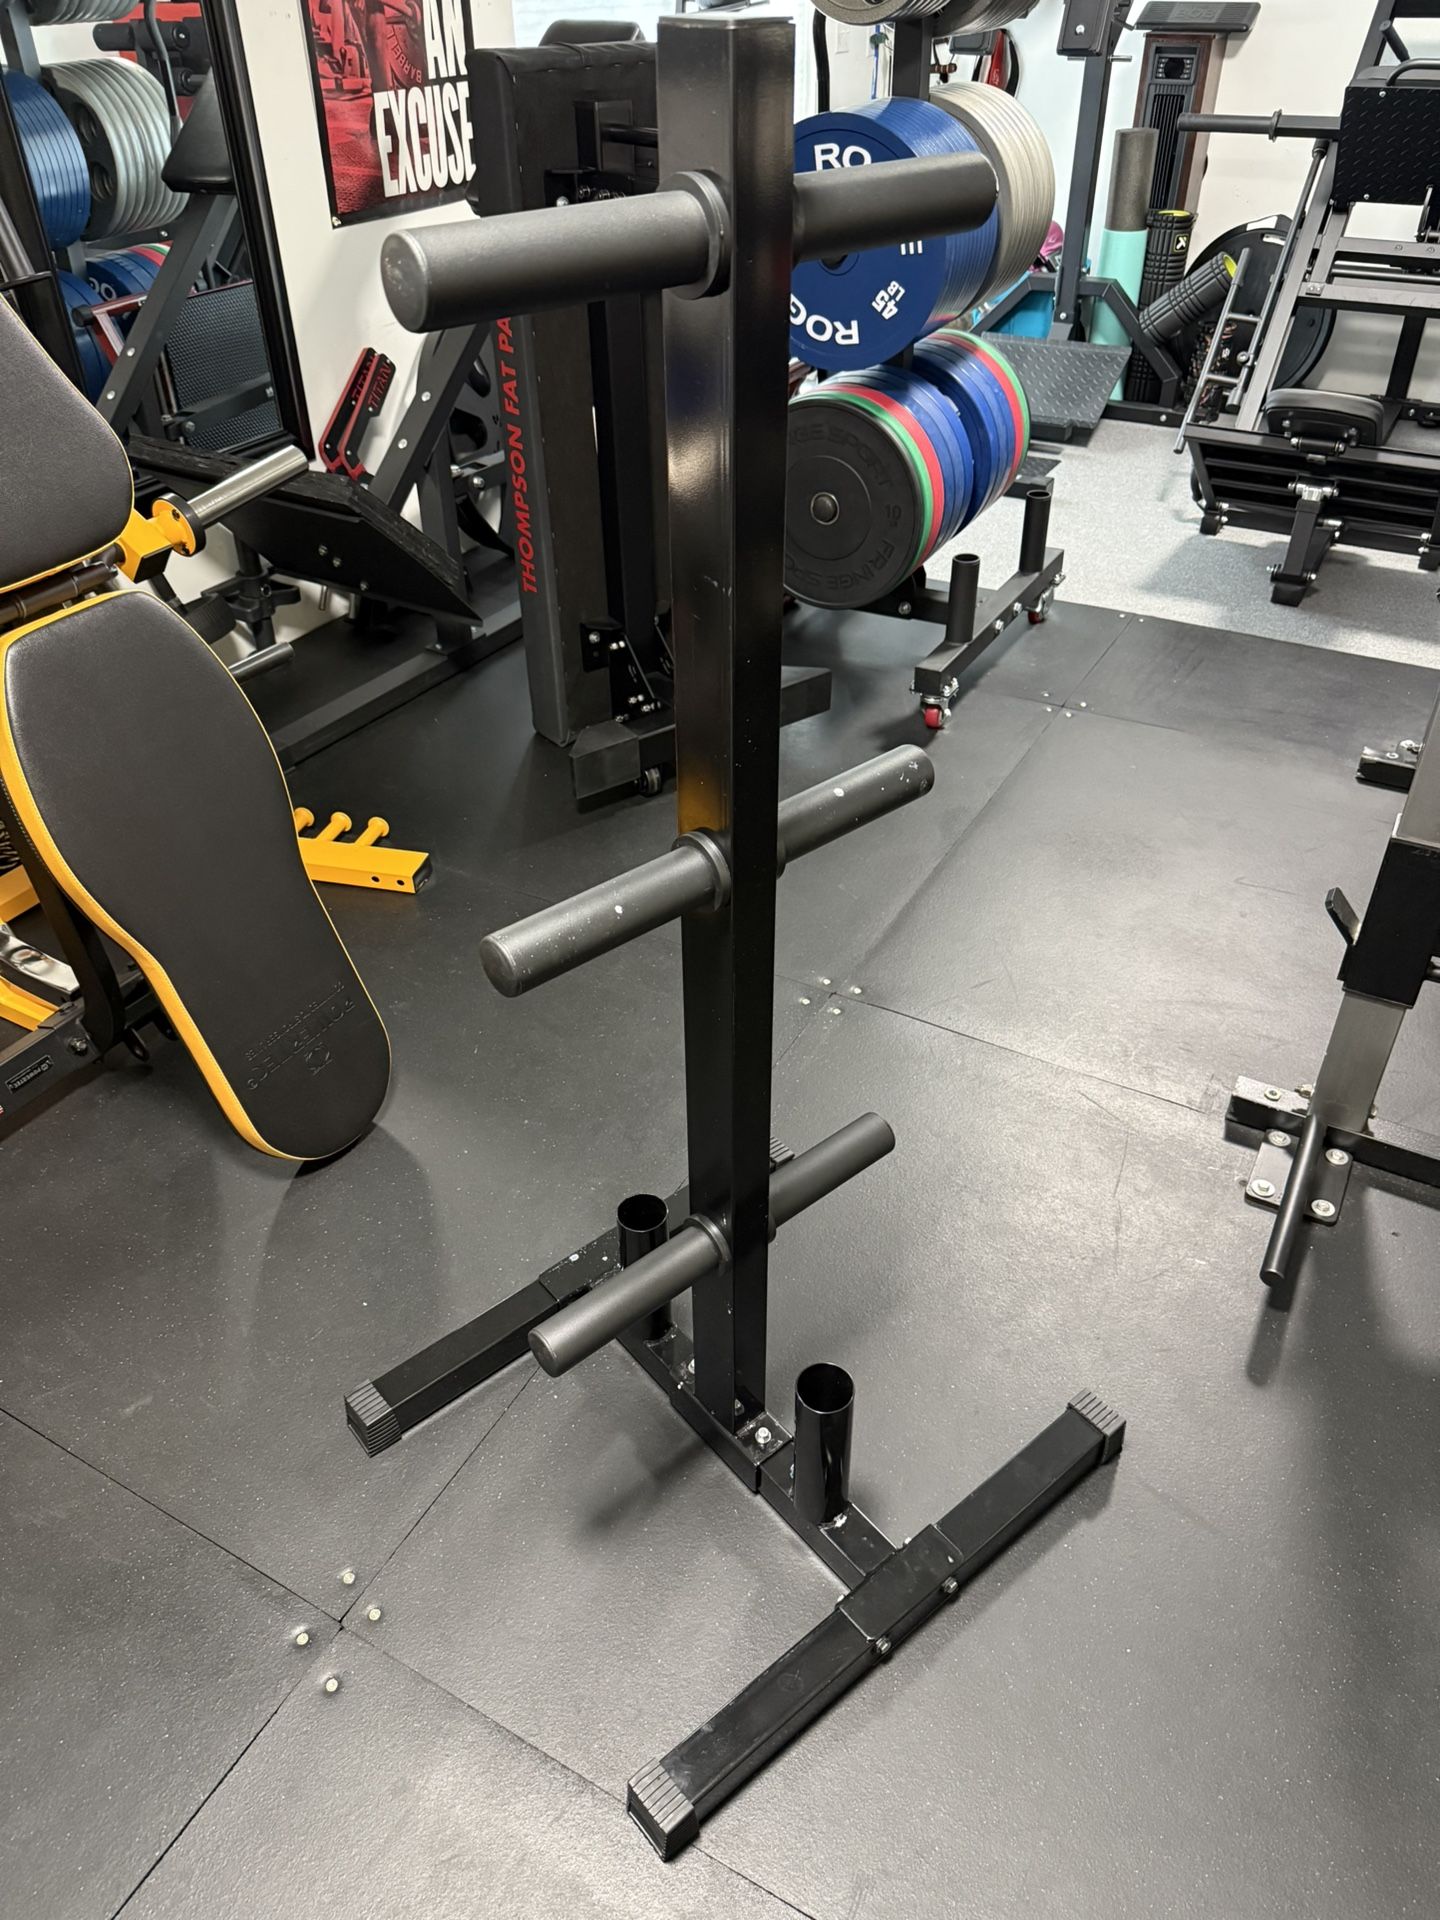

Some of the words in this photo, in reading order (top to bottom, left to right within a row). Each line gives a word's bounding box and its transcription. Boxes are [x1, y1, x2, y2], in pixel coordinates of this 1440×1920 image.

[422, 0, 468, 80] AN
[373, 81, 477, 198] EXCUSE
[496, 317, 514, 354] PA
[789, 293, 860, 346] ROG
[501, 360, 520, 416] FAT
[507, 424, 537, 593] THOMPSON
